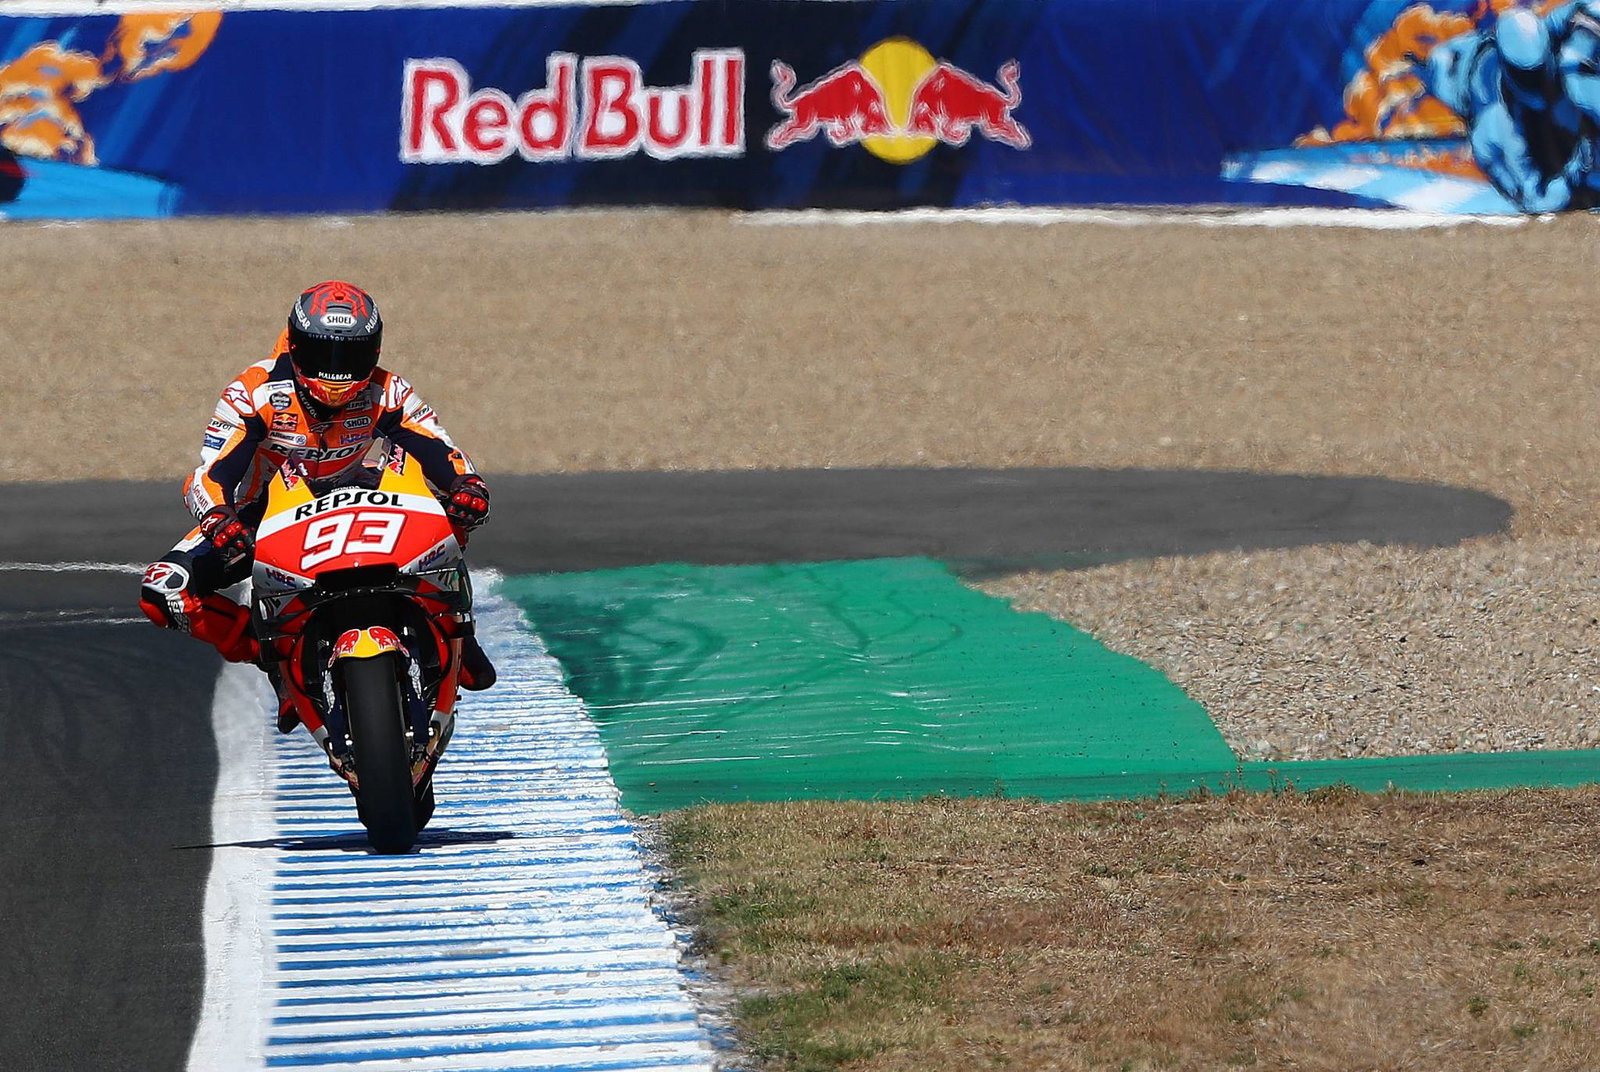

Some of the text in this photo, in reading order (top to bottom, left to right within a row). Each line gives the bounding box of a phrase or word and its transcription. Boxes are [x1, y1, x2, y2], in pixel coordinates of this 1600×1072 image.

[402, 48, 746, 164] Red Bull
[326, 315, 352, 325] SHOEI
[294, 490, 404, 521] REPSOL
[300, 511, 407, 571] 93
